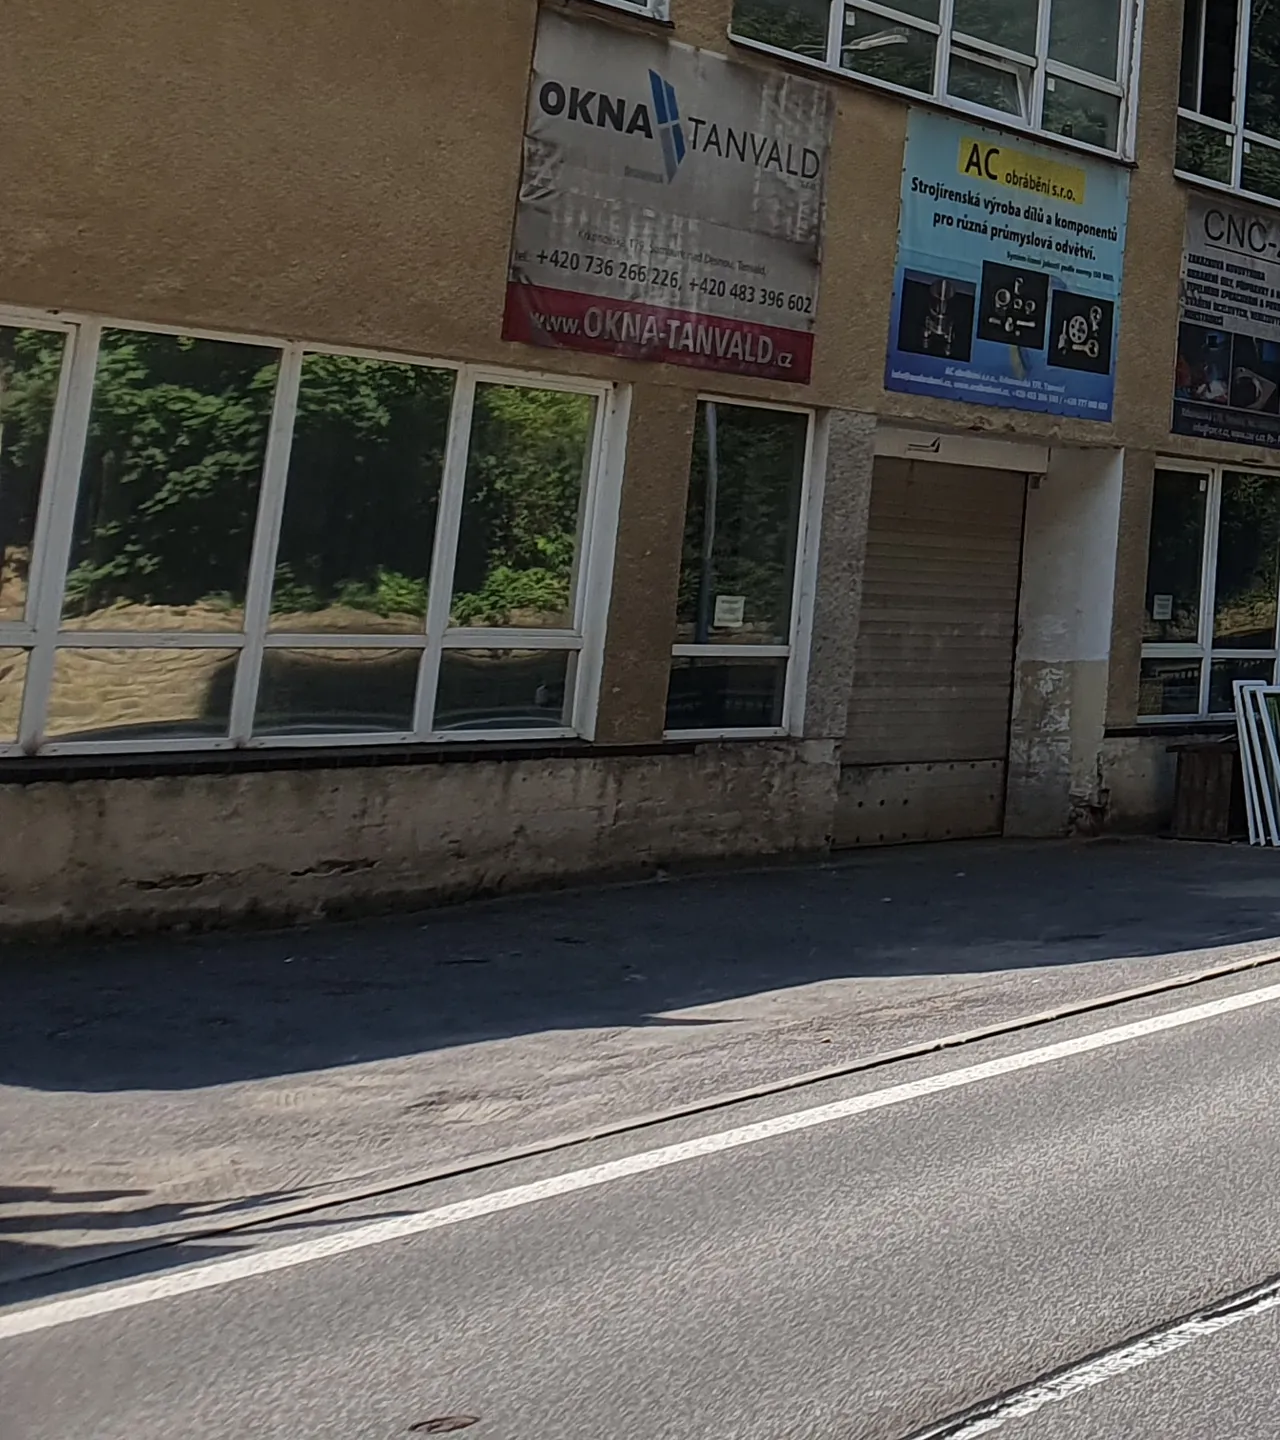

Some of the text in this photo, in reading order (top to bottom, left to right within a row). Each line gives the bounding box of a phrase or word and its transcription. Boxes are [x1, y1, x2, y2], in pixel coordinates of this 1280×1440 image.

[539, 80, 821, 180] OKNA TANVALD
[964, 142, 1076, 202] AC obrábění s.r.o.
[911, 177, 1118, 242] Strojírenská výroba dílů a komponentů
[933, 211, 954, 231] pro
[956, 213, 988, 236] různá
[990, 222, 1054, 252] průmyslová
[1054, 236, 1097, 262] odvětví.
[536, 249, 580, 271] +420
[585, 254, 614, 277] 736
[618, 261, 647, 283] 266
[651, 267, 682, 292] 226,
[688, 276, 726, 298] +420
[729, 282, 756, 303] 483
[758, 287, 785, 310] 396
[787, 293, 813, 315] 602
[531, 305, 793, 369] www.OKNA-TANVALD.cz
